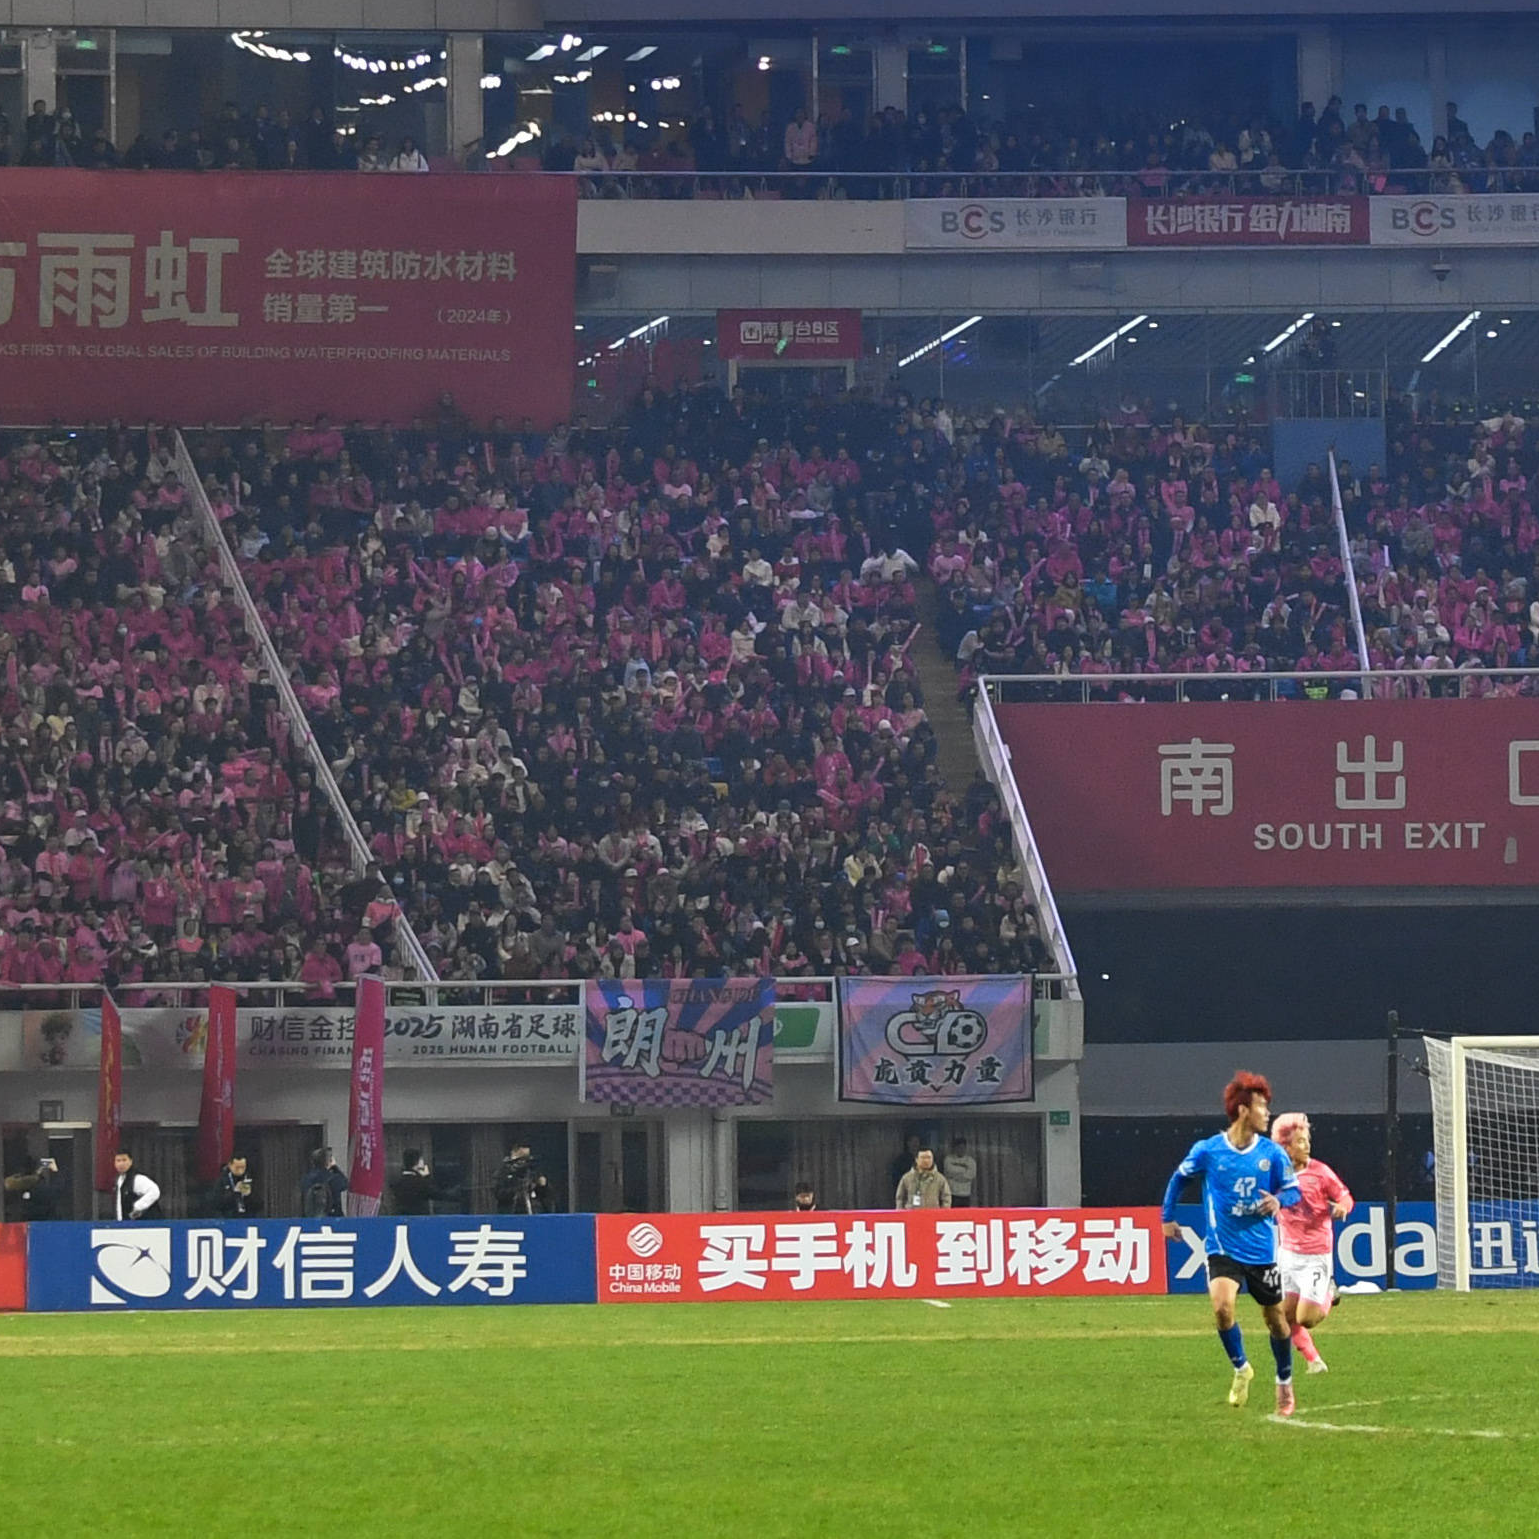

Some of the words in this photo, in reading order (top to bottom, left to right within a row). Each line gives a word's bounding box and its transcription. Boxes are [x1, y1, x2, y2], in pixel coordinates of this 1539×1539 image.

[941, 210, 1006, 233] BCS
[1392, 207, 1456, 230] BCS
[264, 248, 517, 282] 全球建筑防水材料
[263, 293, 389, 325] 销量第一
[21, 343, 62, 357] FIRST
[86, 344, 145, 358] GLOBAL
[147, 345, 194, 359] SALES
[221, 346, 291, 360] BUILDING
[294, 347, 424, 361] WATERPROOFING
[428, 348, 511, 362] MATERIALS
[1254, 822, 1383, 851] SOUTH
[1404, 822, 1486, 850] EXIT
[413, 1044, 443, 1054] 2025
[450, 1044, 497, 1054] HUNAN
[502, 1043, 572, 1054] FOOTBALL
[1234, 1177, 1256, 1198] 47
[185, 1224, 527, 1300] 财信人寿
[698, 1223, 918, 1290] 买手机
[935, 1218, 1150, 1285] 到移动
[609, 1264, 681, 1281] 中国移动
[610, 1281, 641, 1293] China
[644, 1280, 681, 1293] Mobile
